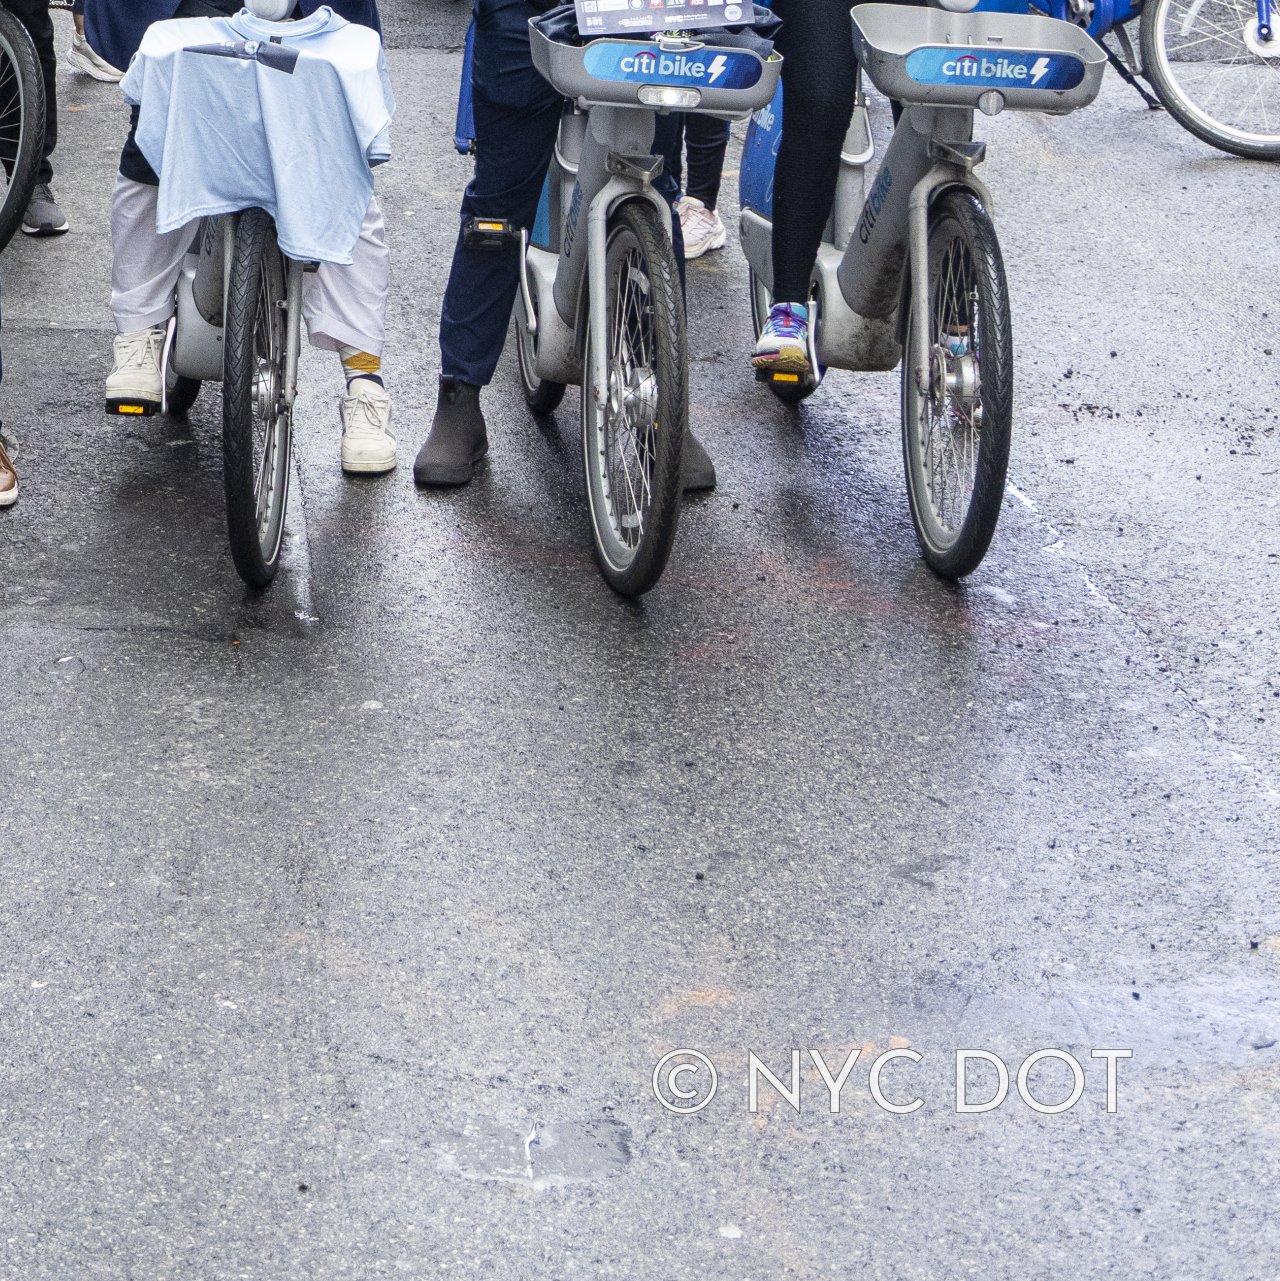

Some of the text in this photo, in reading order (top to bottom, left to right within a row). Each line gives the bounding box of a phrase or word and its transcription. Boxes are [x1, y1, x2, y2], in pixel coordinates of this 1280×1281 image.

[620, 52, 705, 77] citi bike
[942, 55, 1028, 78] citi bike
[858, 166, 893, 244] citi bike
